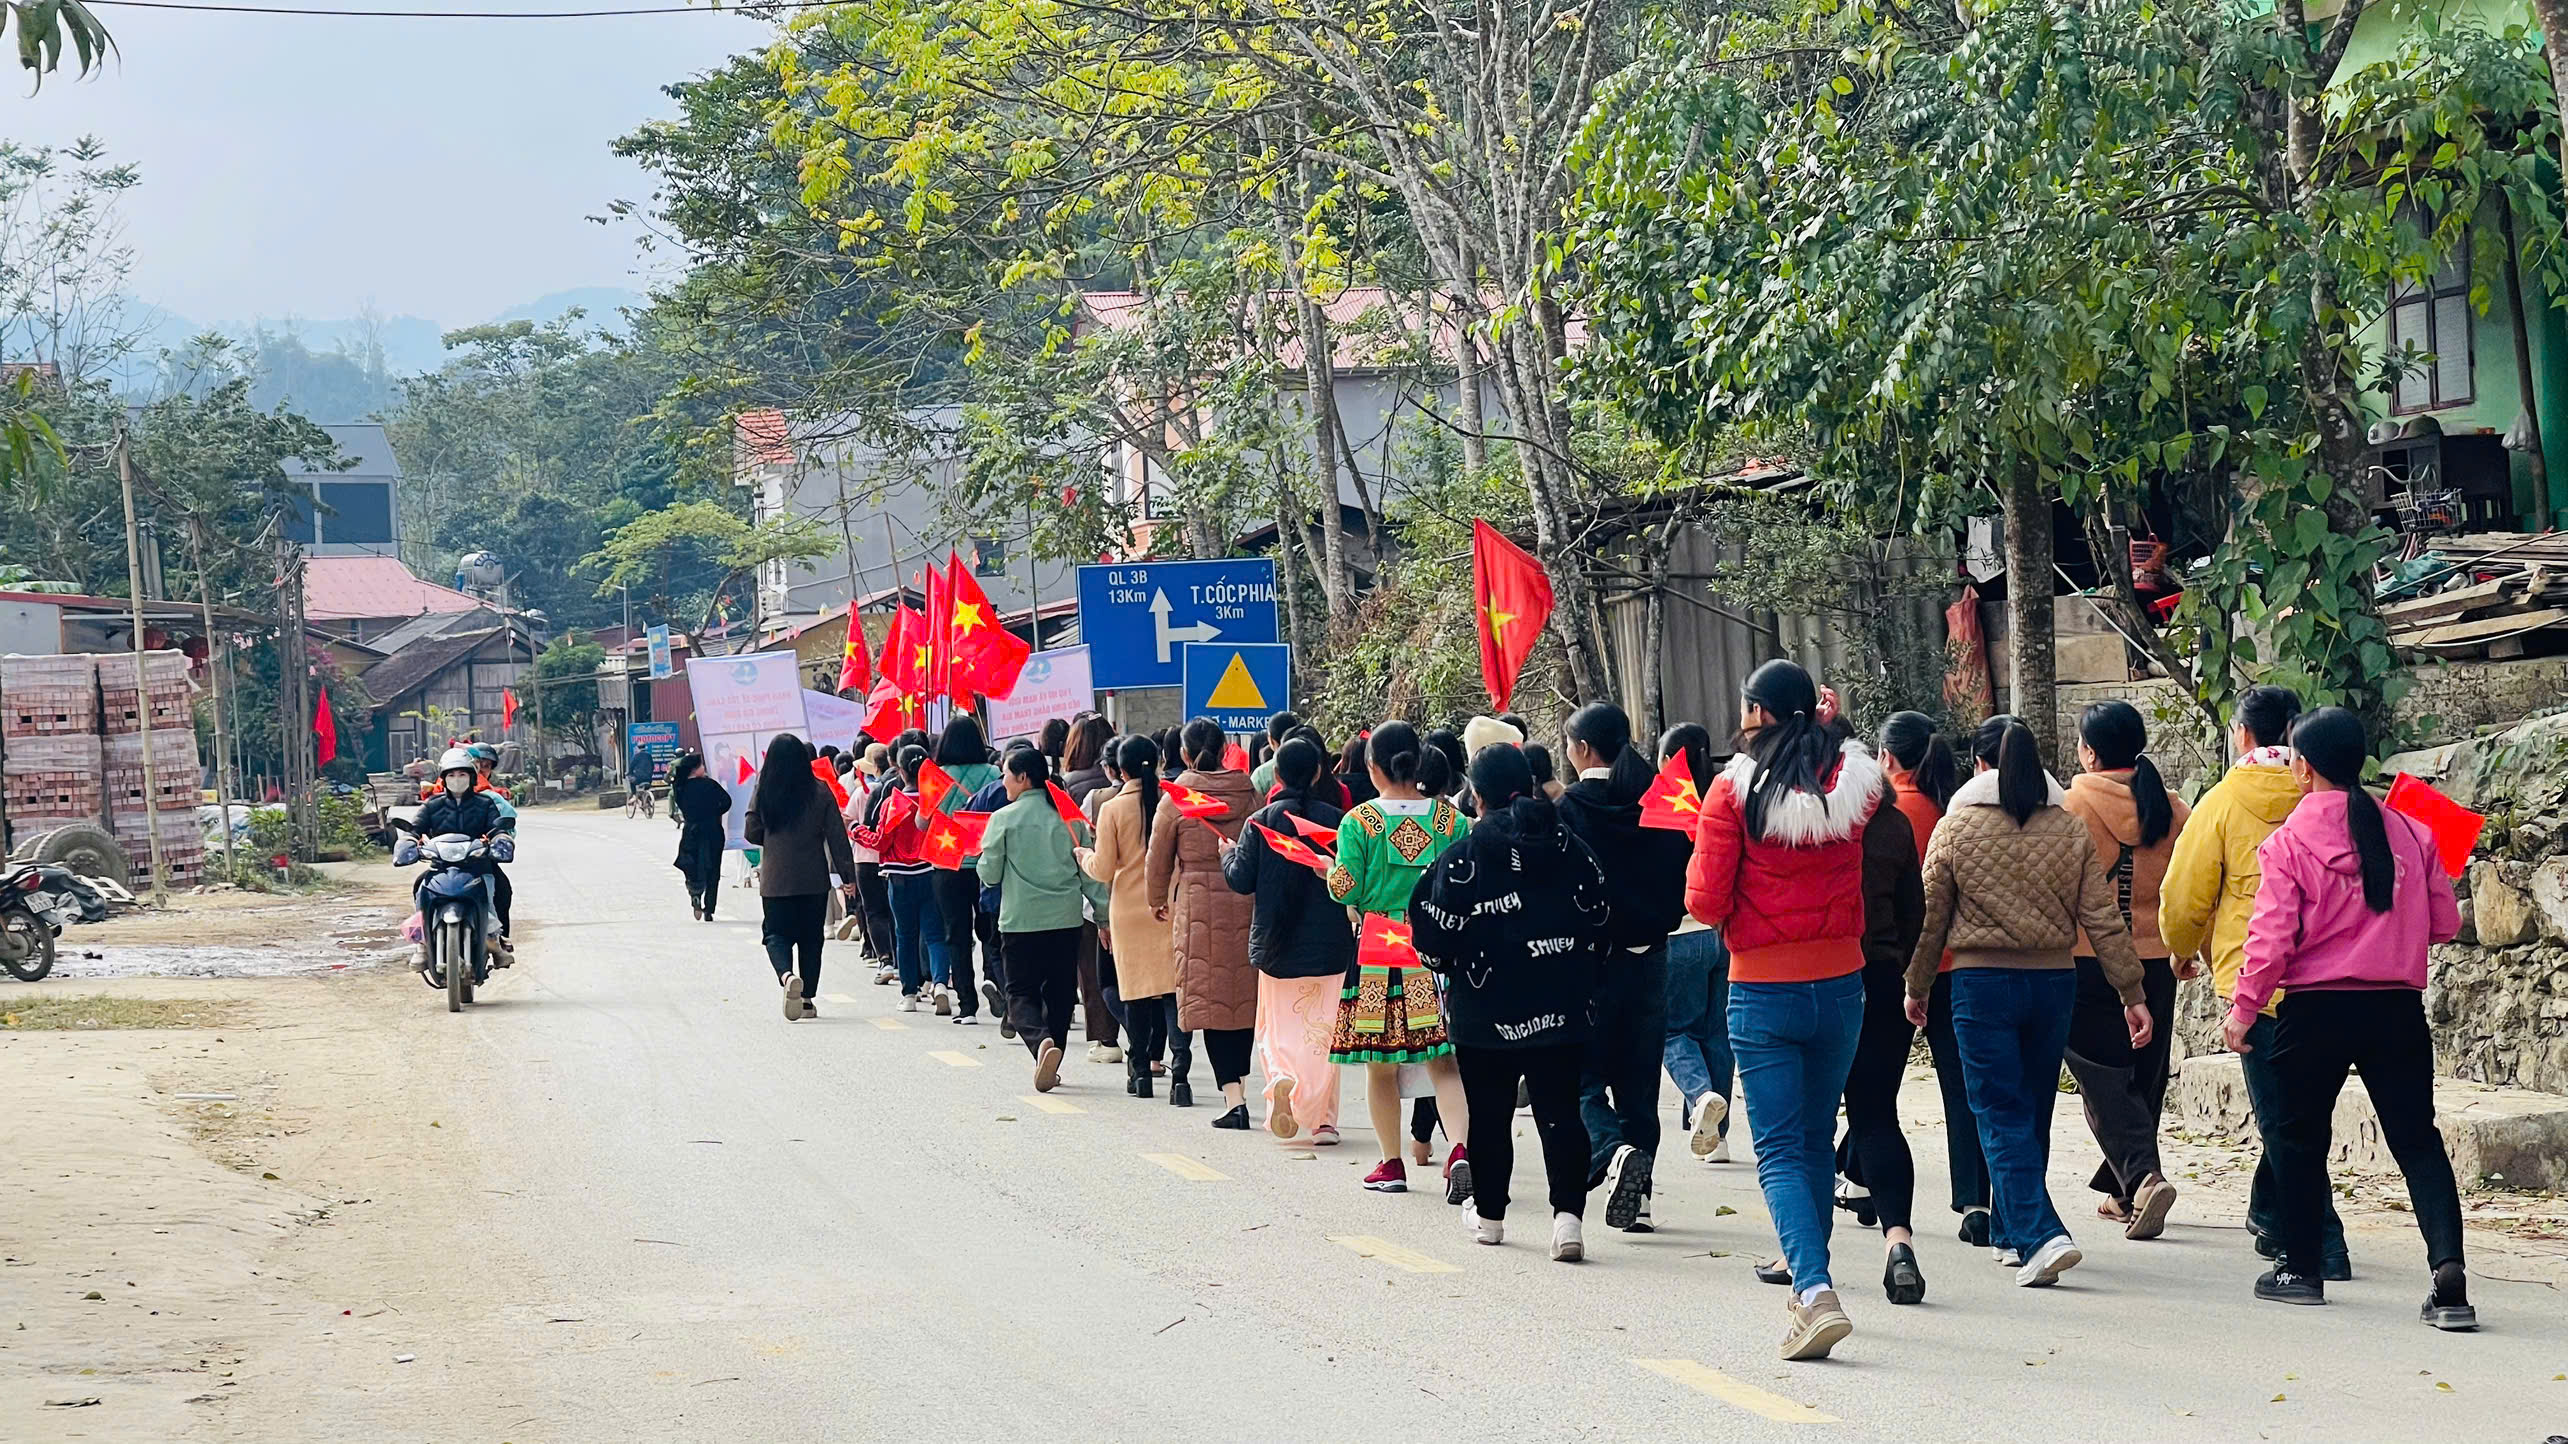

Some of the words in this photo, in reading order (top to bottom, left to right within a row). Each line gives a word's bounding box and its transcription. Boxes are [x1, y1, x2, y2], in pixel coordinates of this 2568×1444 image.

[1108, 571, 1127, 586] QL
[1130, 570, 1148, 584] 3B
[1108, 589, 1147, 604] 13Km
[1215, 605, 1244, 619] 3Km
[1228, 716, 1270, 728] MARKE
[632, 734, 676, 744] PHOTOCOPY
[1471, 891, 1522, 915] SMILEY
[1527, 937, 1575, 957] SMILEY
